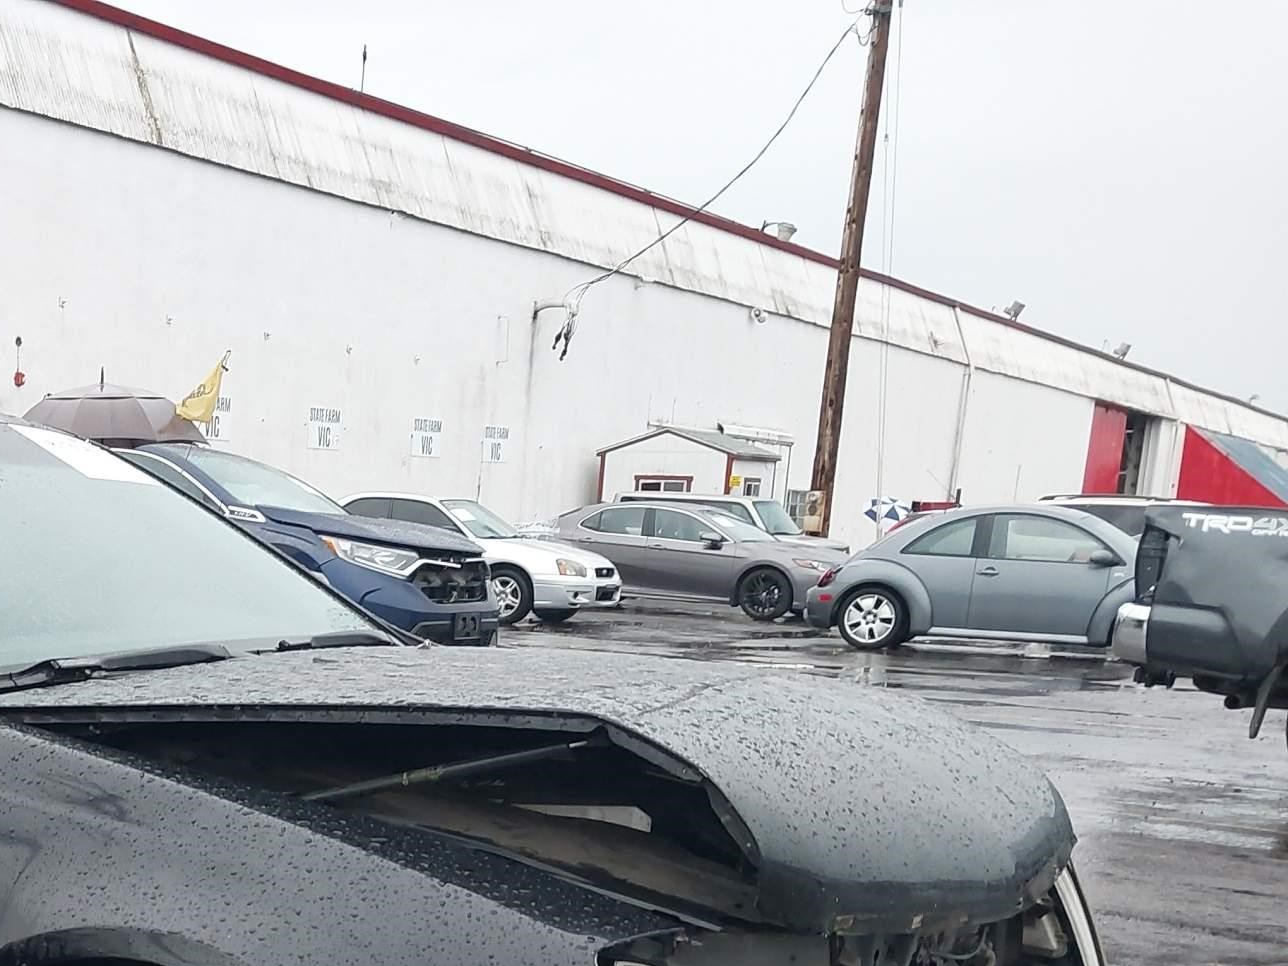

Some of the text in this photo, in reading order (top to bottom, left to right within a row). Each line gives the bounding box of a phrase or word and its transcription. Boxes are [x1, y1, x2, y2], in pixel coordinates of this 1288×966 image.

[215, 397, 231, 413] ARM
[309, 408, 341, 423] STATE FARM
[205, 416, 220, 437] VIC
[414, 418, 442, 433] STATE FARM
[497, 427, 509, 440] FARM
[318, 426, 330, 447] VIC
[421, 435, 433, 455] VIC
[491, 442, 501, 461] VIC
[1182, 512, 1253, 534] TRD
